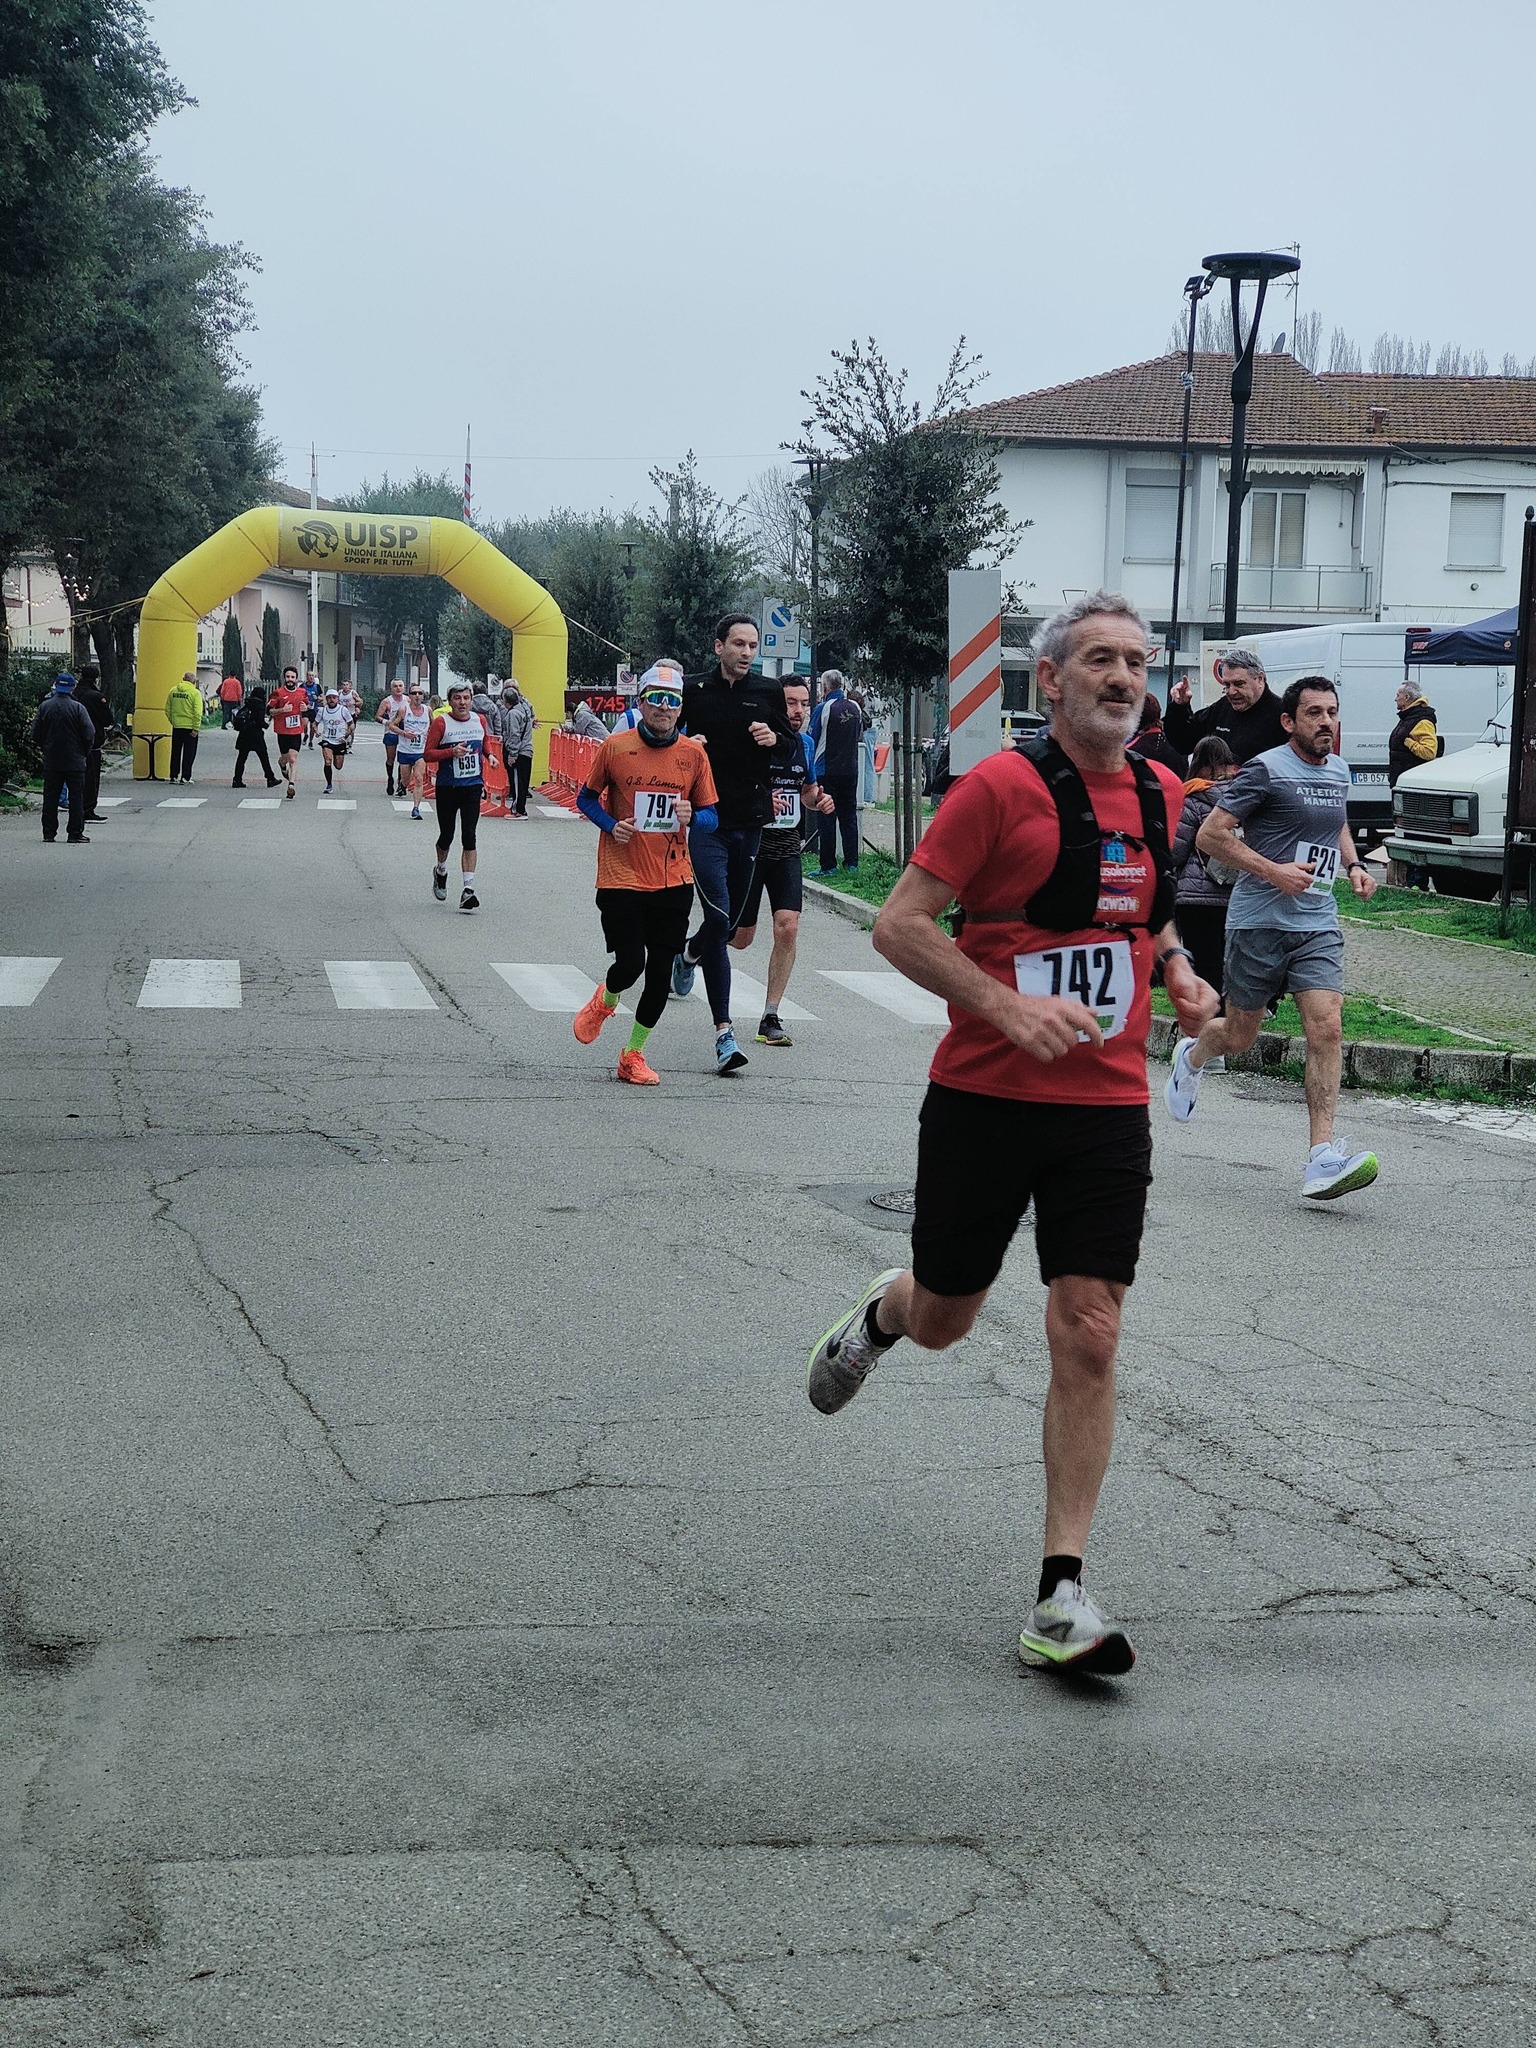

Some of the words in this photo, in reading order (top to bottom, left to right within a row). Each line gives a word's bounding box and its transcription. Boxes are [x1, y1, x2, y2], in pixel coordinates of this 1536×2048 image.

[344, 522, 418, 548] UISP
[344, 548, 377, 557] UNIONE
[380, 550, 418, 559] ITALIANA
[344, 556, 370, 564] SPORT
[766, 635, 774, 645] P
[459, 755, 476, 770] 639
[1296, 787, 1343, 797] ATLETICA
[647, 794, 677, 818] 797
[1305, 845, 1336, 880] 624
[1042, 947, 1116, 1007] 742
